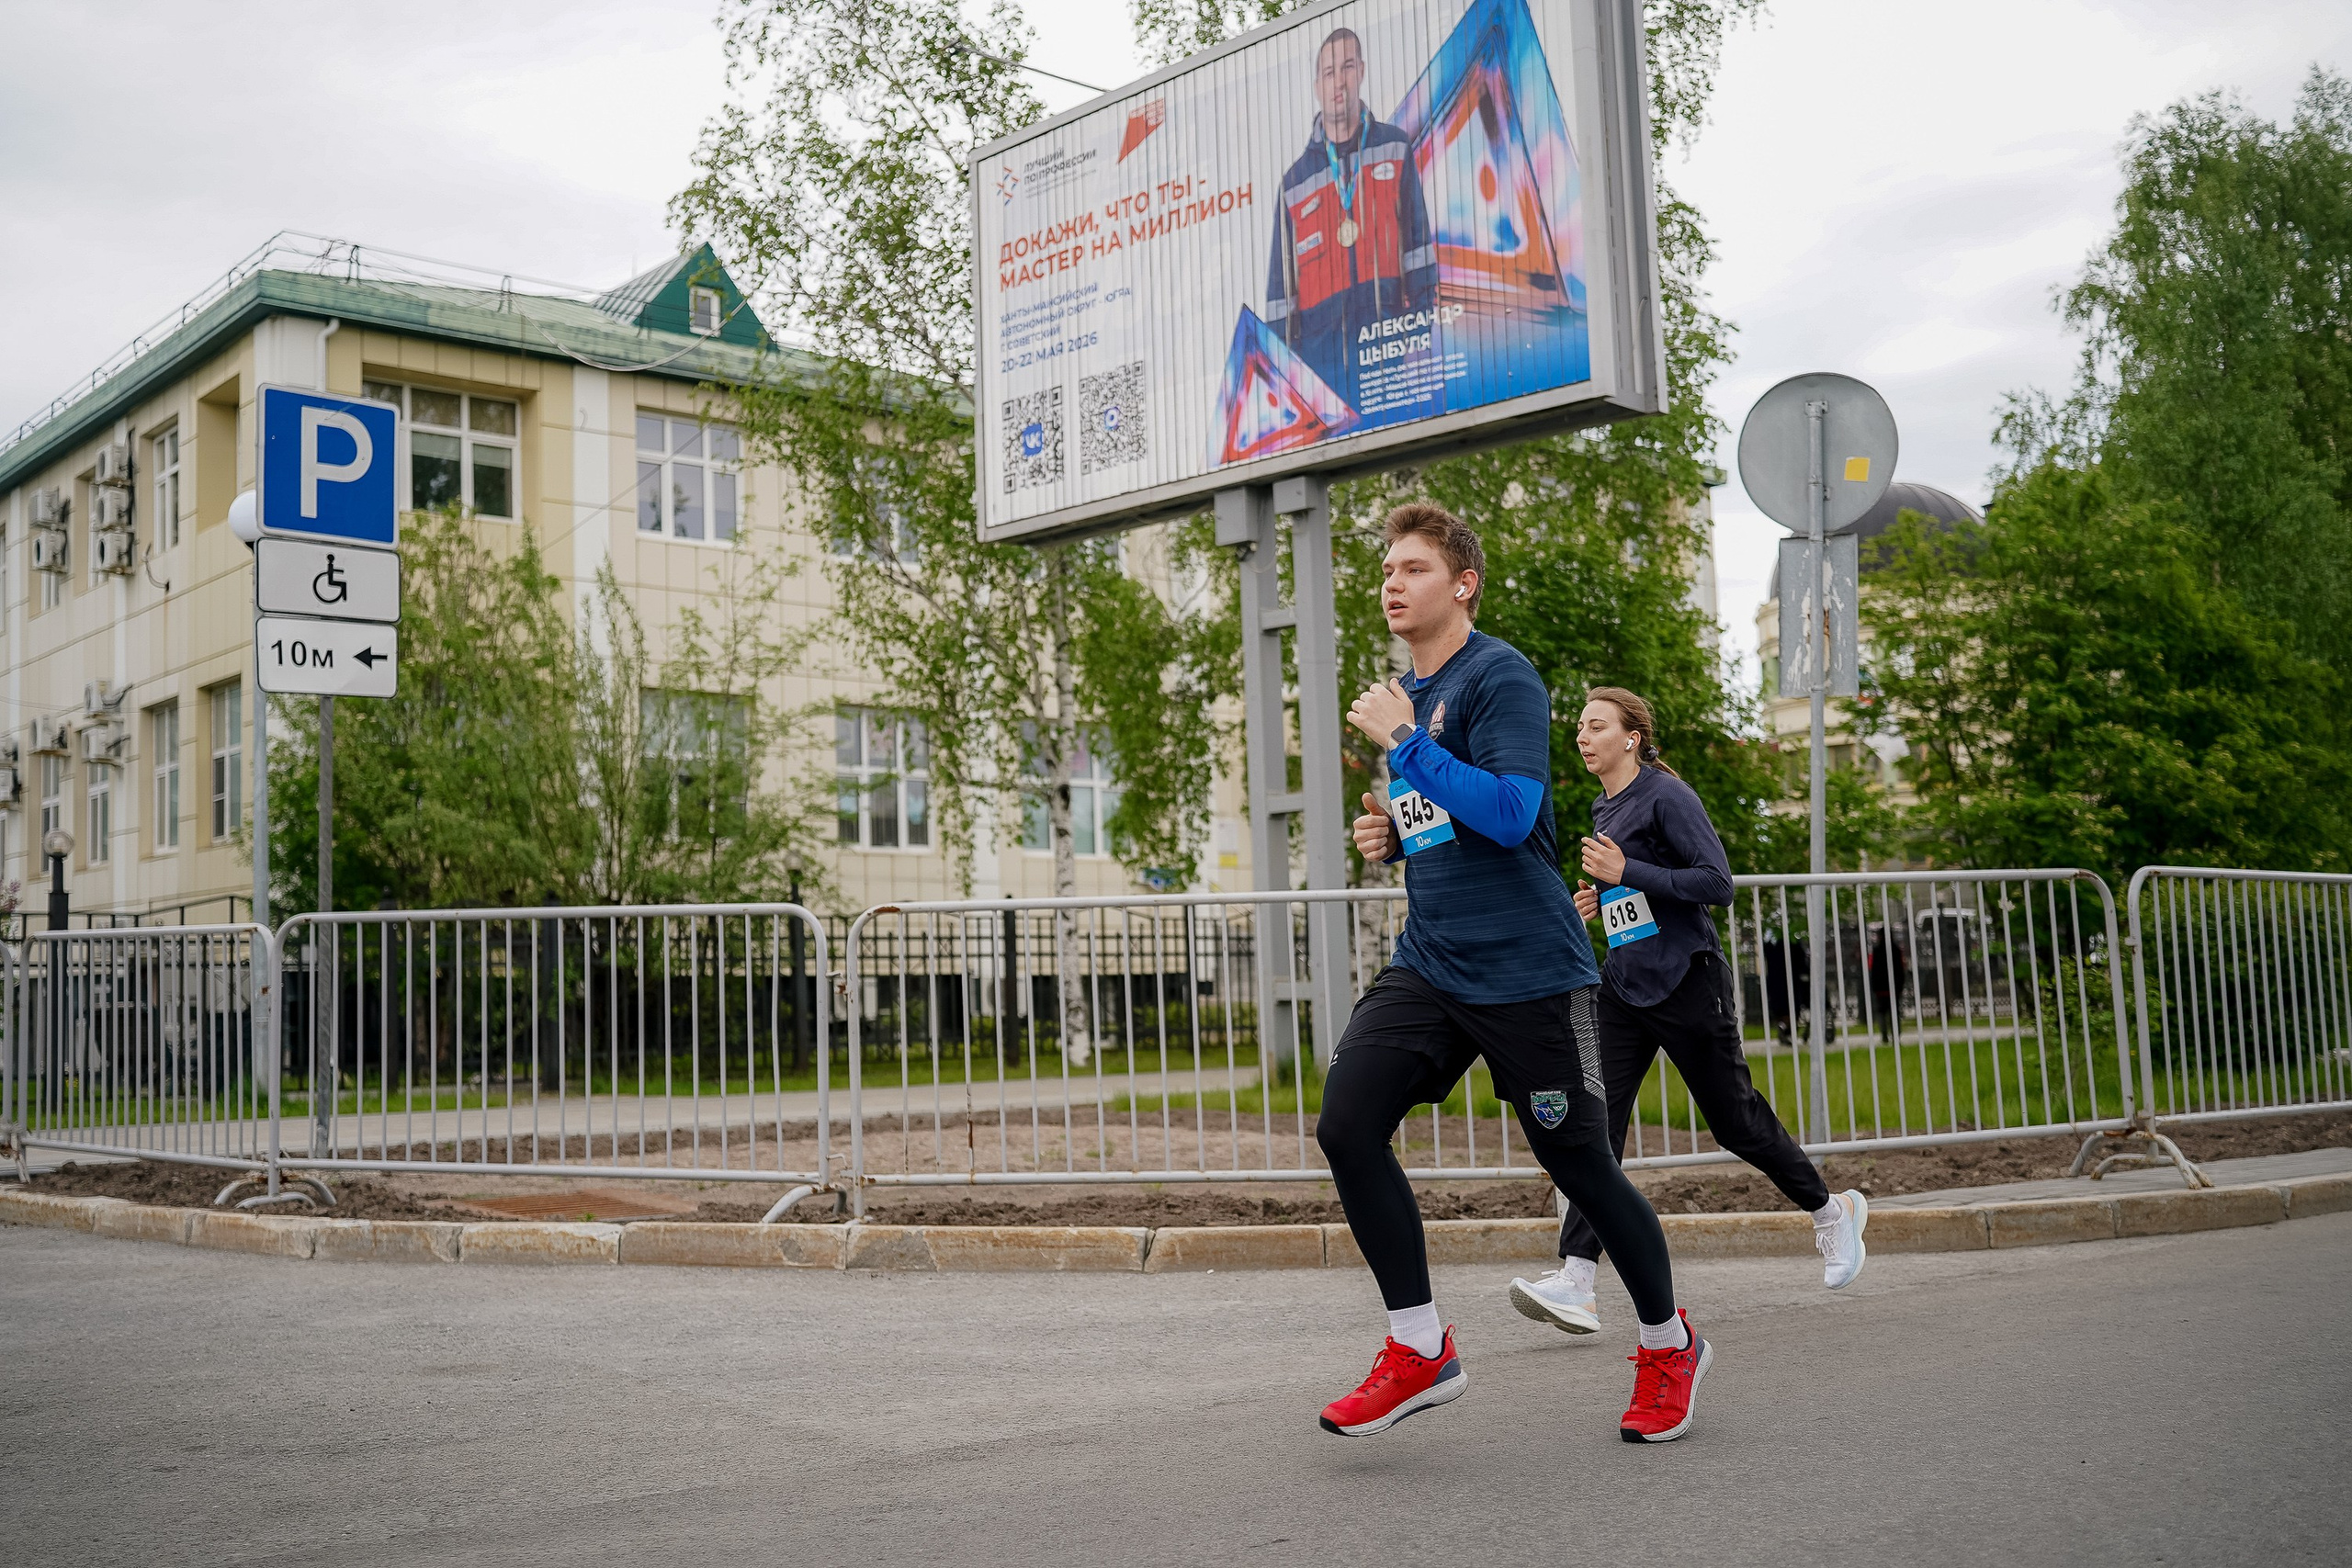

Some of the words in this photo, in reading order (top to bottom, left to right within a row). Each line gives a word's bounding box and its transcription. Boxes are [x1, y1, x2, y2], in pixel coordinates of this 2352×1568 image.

[1023, 147, 1064, 173] ЛУЧШИЙ
[1024, 174, 1036, 185] ПО
[1038, 149, 1096, 180] ПРОФЕССИИ
[999, 211, 1100, 269] ДОКАЖИ,
[1105, 191, 1149, 221] ЧТО
[1157, 175, 1193, 205] ТЫ
[1000, 244, 1083, 293] МАСТЕР
[1091, 231, 1124, 262] НА
[1129, 182, 1253, 247] МИЛЛИОН
[1001, 309, 1064, 337] АВТОНОМНЫЙ
[1067, 299, 1096, 316] ОКРУГ
[1358, 303, 1464, 344] АЛЕКСАНДР
[1001, 353, 1033, 373] 20-22
[1035, 343, 1063, 362] МАЯ
[1068, 332, 1098, 352] 2026
[1359, 333, 1431, 367] ЦЫБУЛЯ
[300, 405, 374, 519] P
[1400, 795, 1434, 829] 545
[1610, 901, 1638, 929] 618
